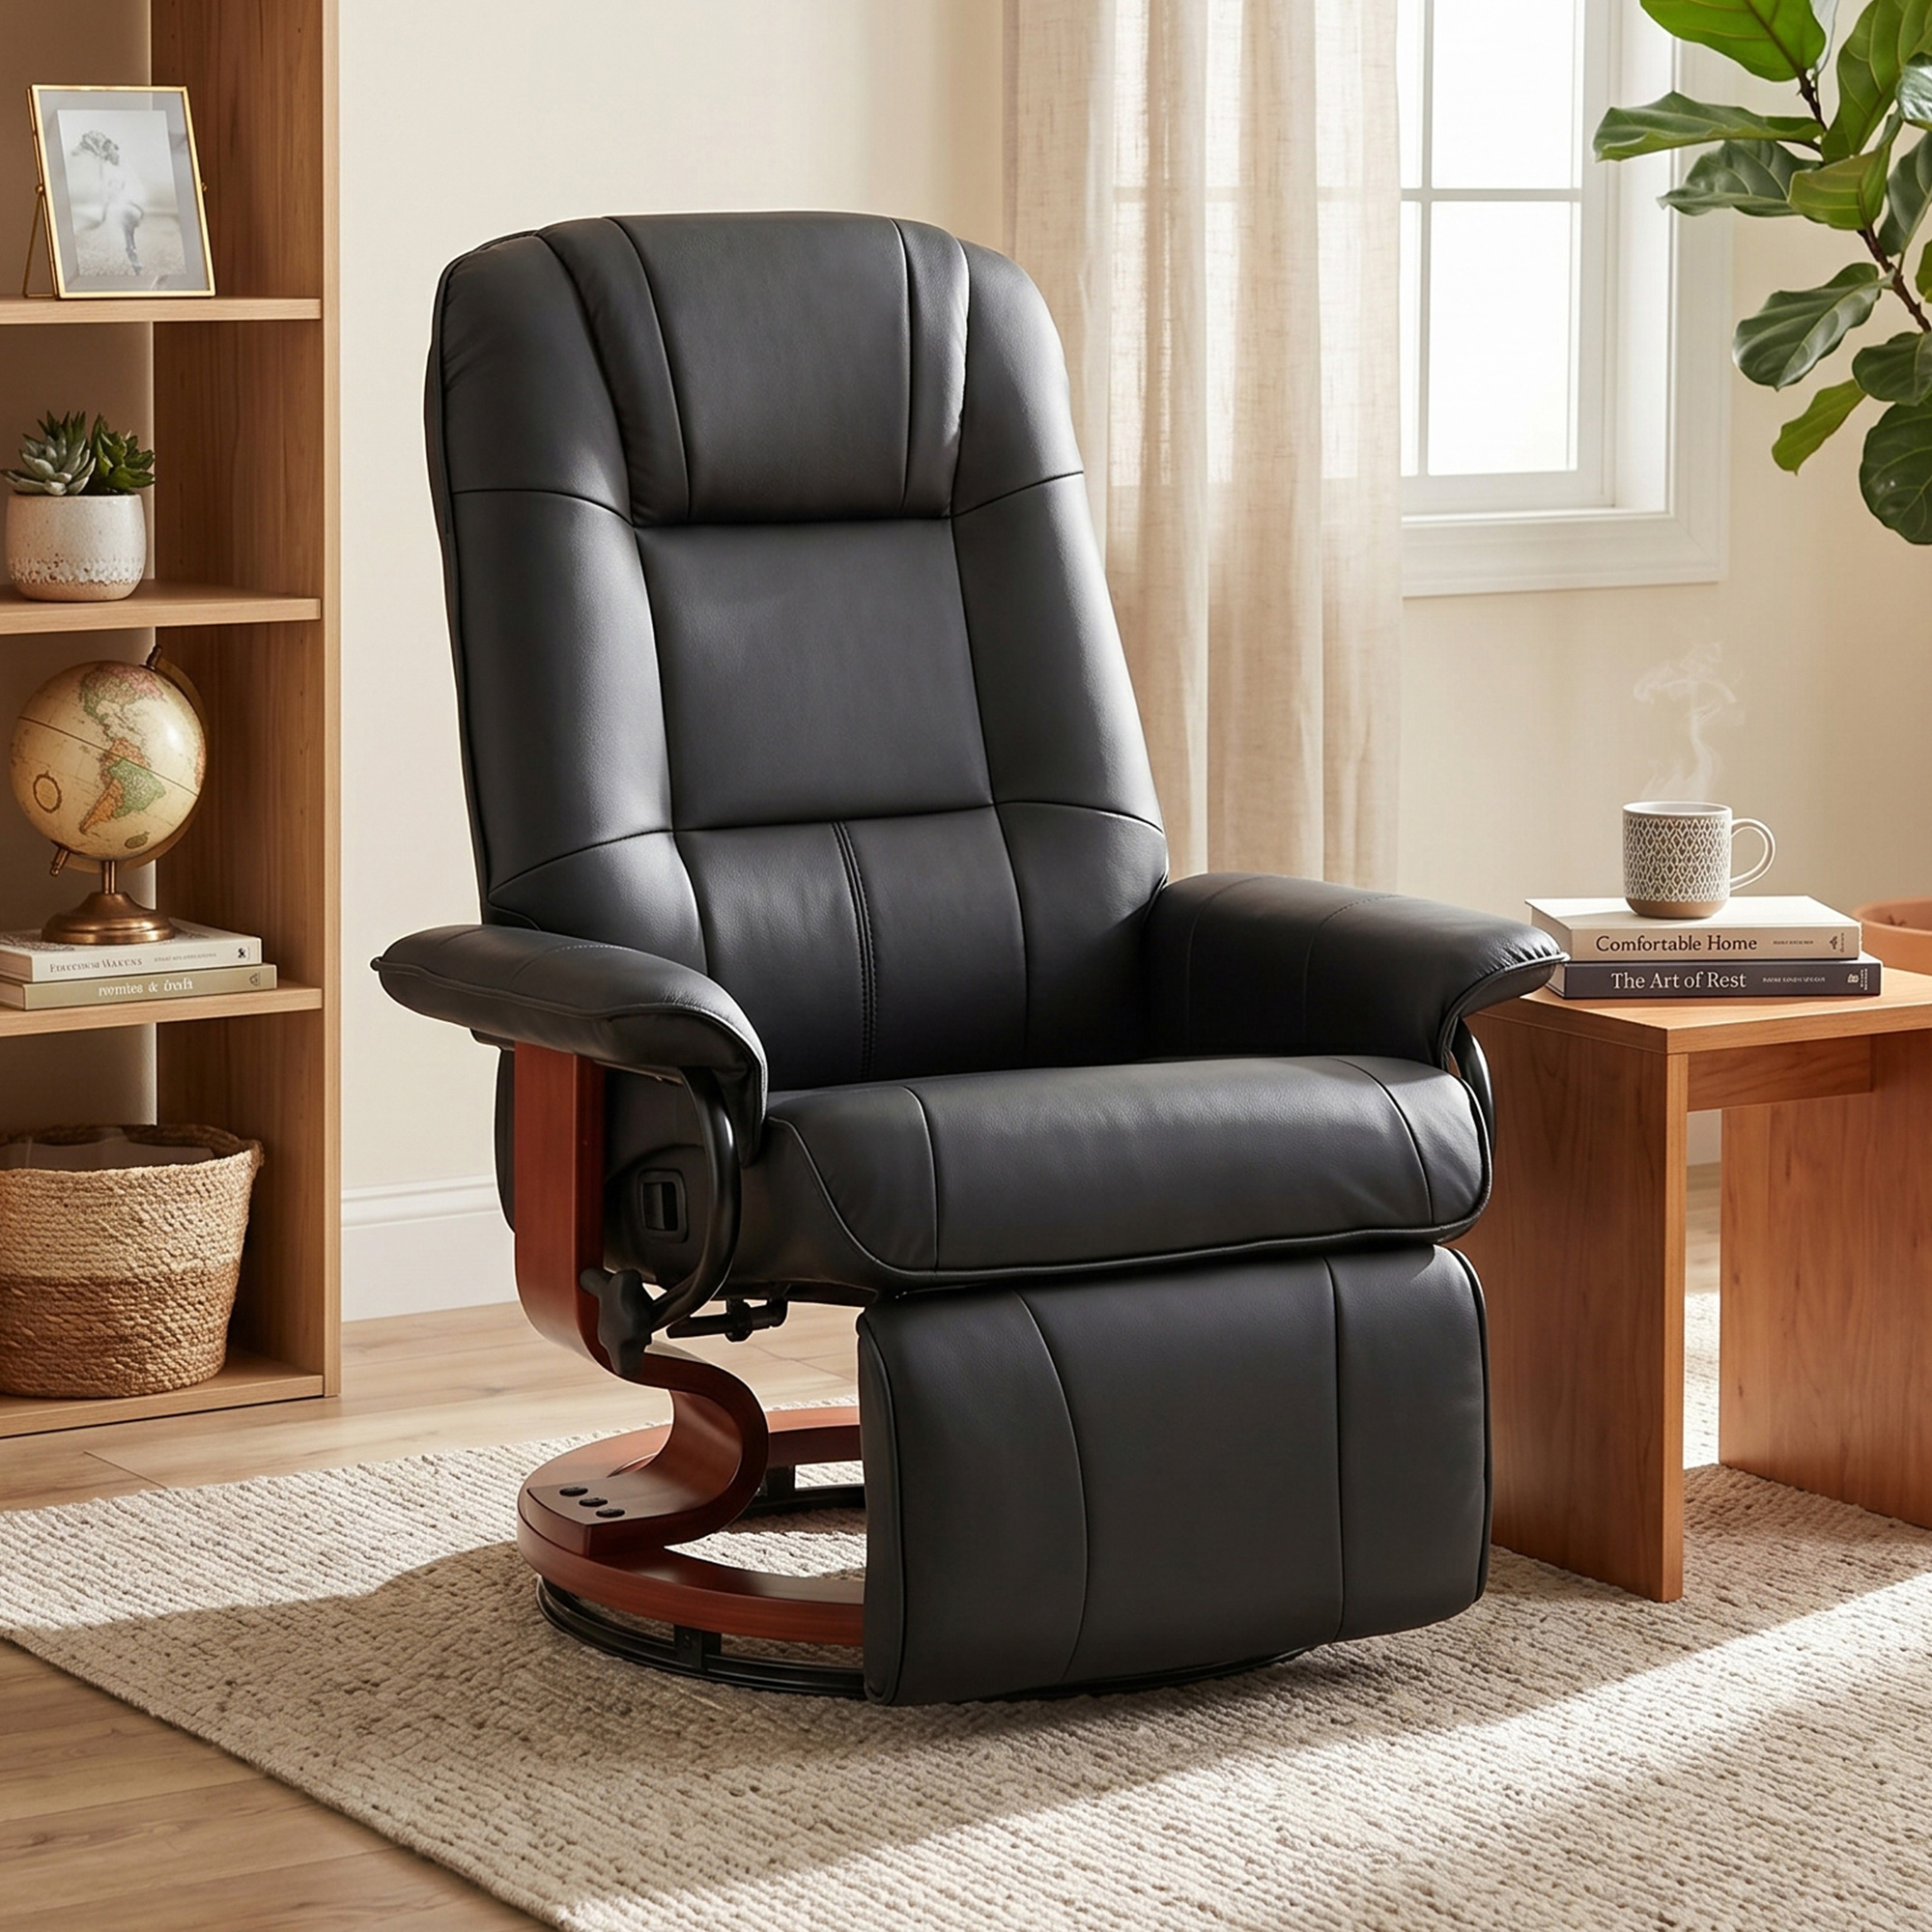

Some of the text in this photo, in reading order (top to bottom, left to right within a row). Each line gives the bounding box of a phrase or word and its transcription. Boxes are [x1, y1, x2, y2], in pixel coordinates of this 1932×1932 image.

[1596, 934, 1757, 952] Comfortable Home
[1611, 972, 1646, 989] The
[1650, 972, 1680, 989] Art
[1684, 971, 1704, 988] of
[1707, 972, 1747, 988] Rest
